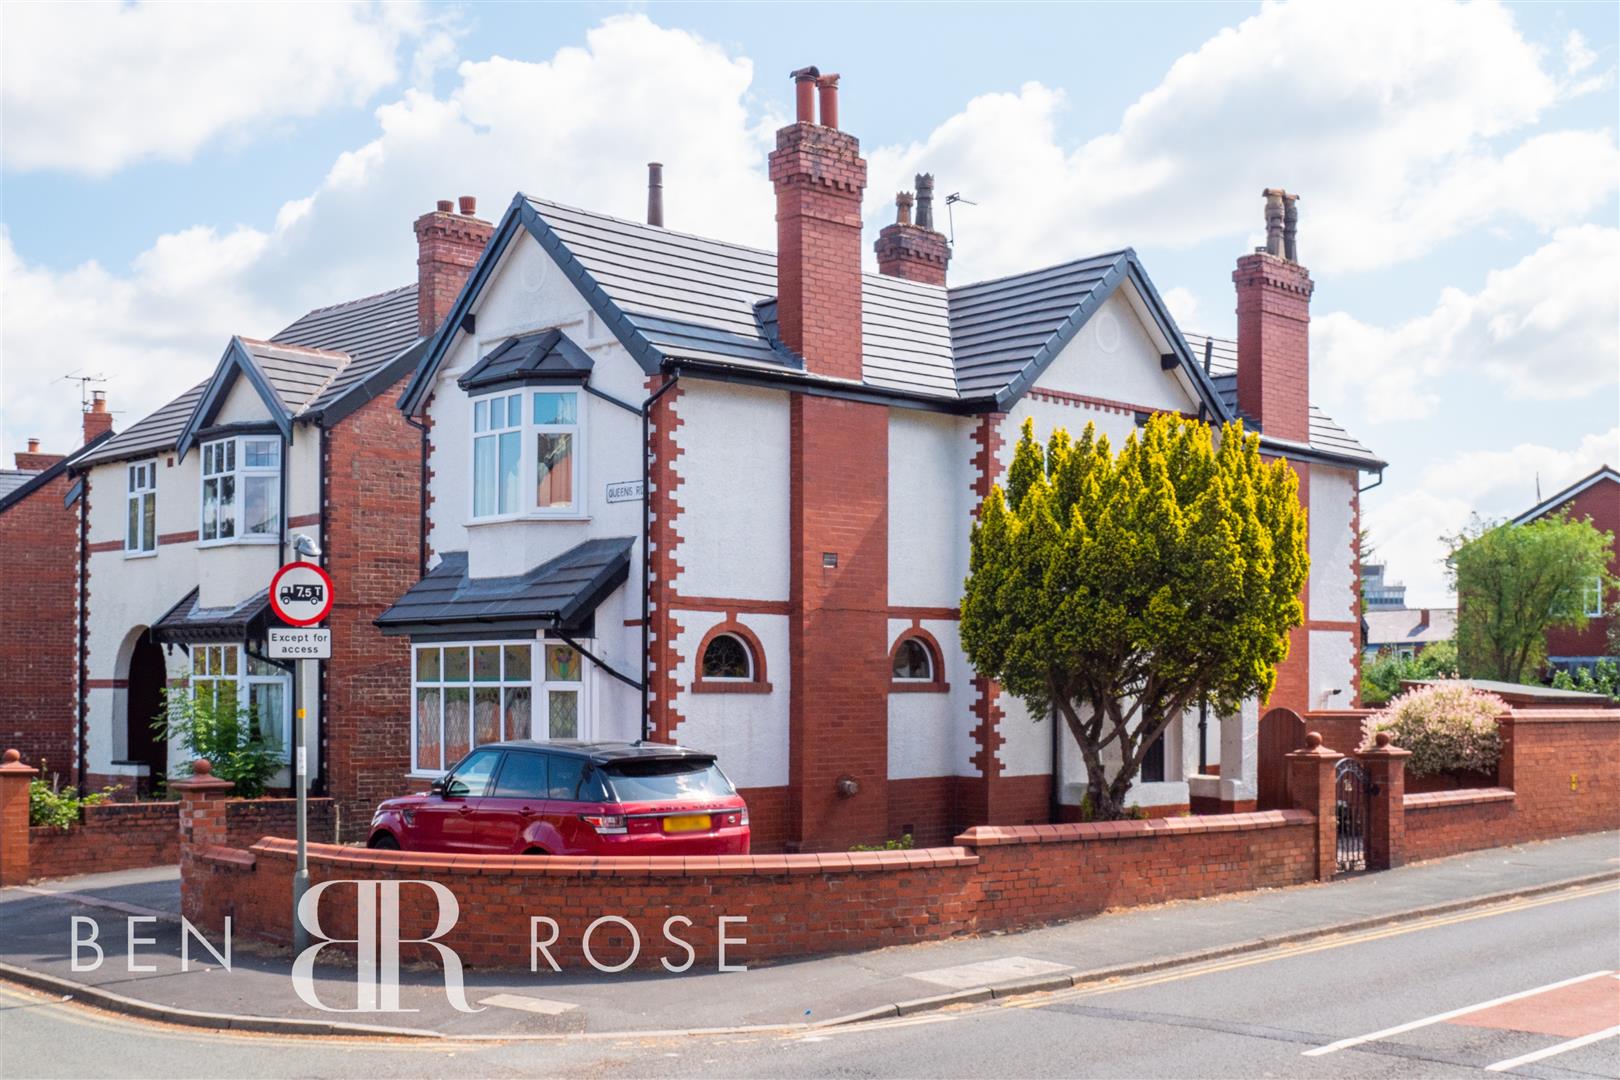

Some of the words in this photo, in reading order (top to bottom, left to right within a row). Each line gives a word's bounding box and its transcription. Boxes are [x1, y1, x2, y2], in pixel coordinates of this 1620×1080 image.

[608, 487, 633, 498] QUEENS
[296, 586, 312, 598] 7.5
[315, 586, 321, 596] T
[271, 633, 309, 643] Except
[313, 633, 328, 642] for
